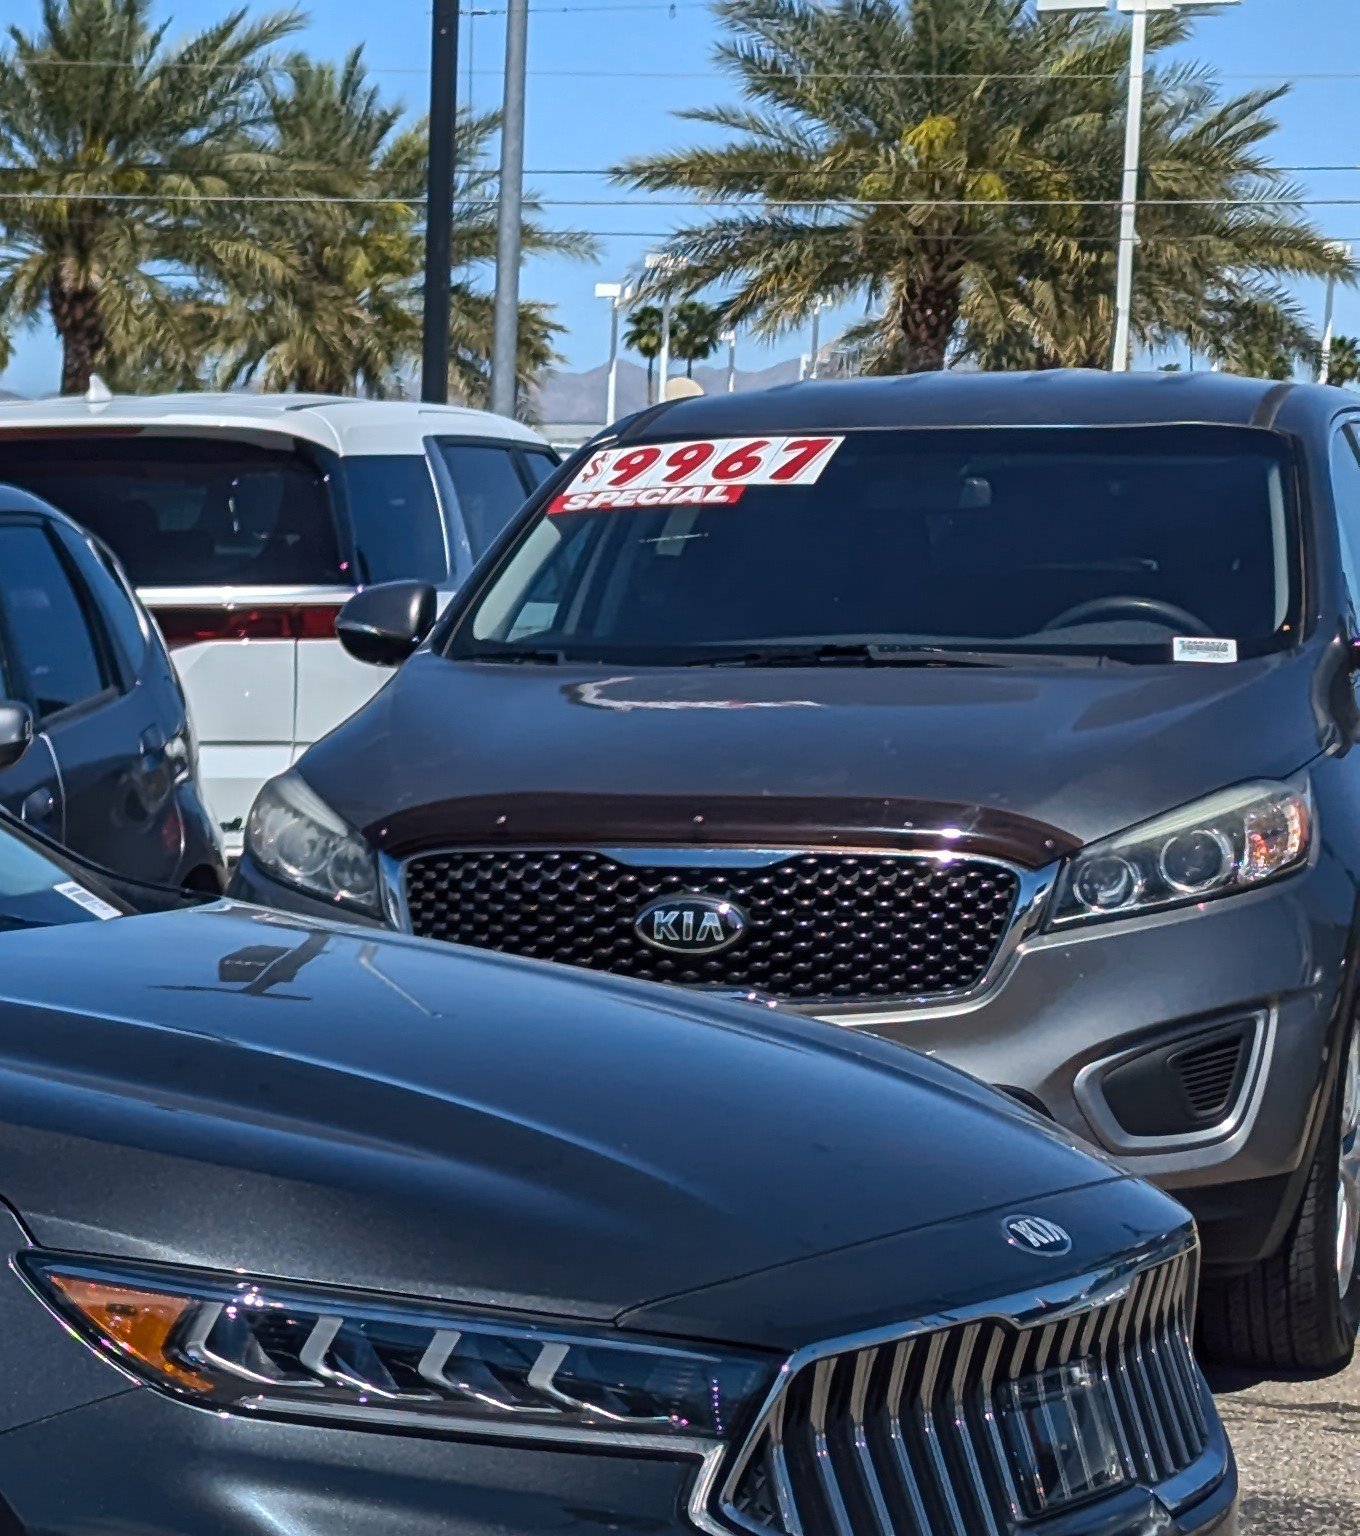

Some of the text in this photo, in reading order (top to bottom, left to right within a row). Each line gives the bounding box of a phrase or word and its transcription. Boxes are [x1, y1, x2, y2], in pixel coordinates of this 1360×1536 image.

[582, 438, 834, 486] $9967
[563, 485, 730, 511] SPECIAL
[654, 910, 724, 941] KIA
[1009, 1217, 1068, 1247] KIA
